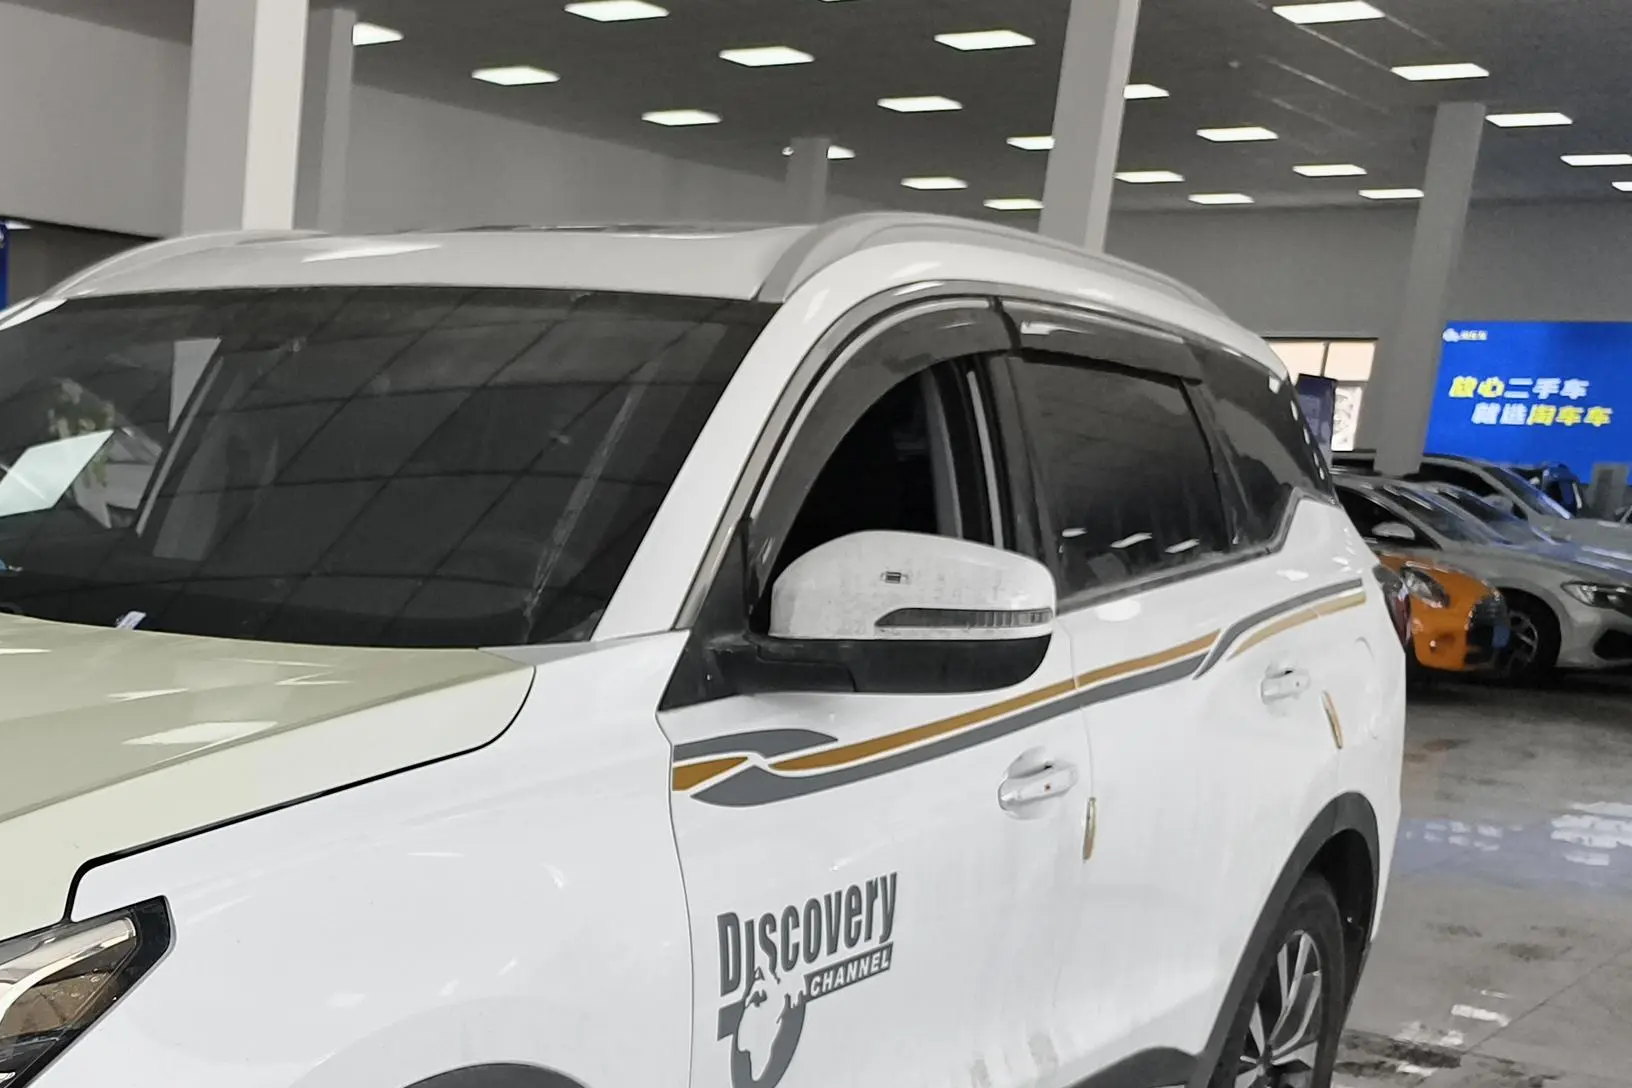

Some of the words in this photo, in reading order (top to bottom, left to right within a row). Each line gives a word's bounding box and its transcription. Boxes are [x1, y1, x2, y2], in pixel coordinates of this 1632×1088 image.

[1448, 375, 1590, 400] 放心二手车
[717, 872, 897, 998] Discovery
[809, 949, 890, 997] CHANNEL
